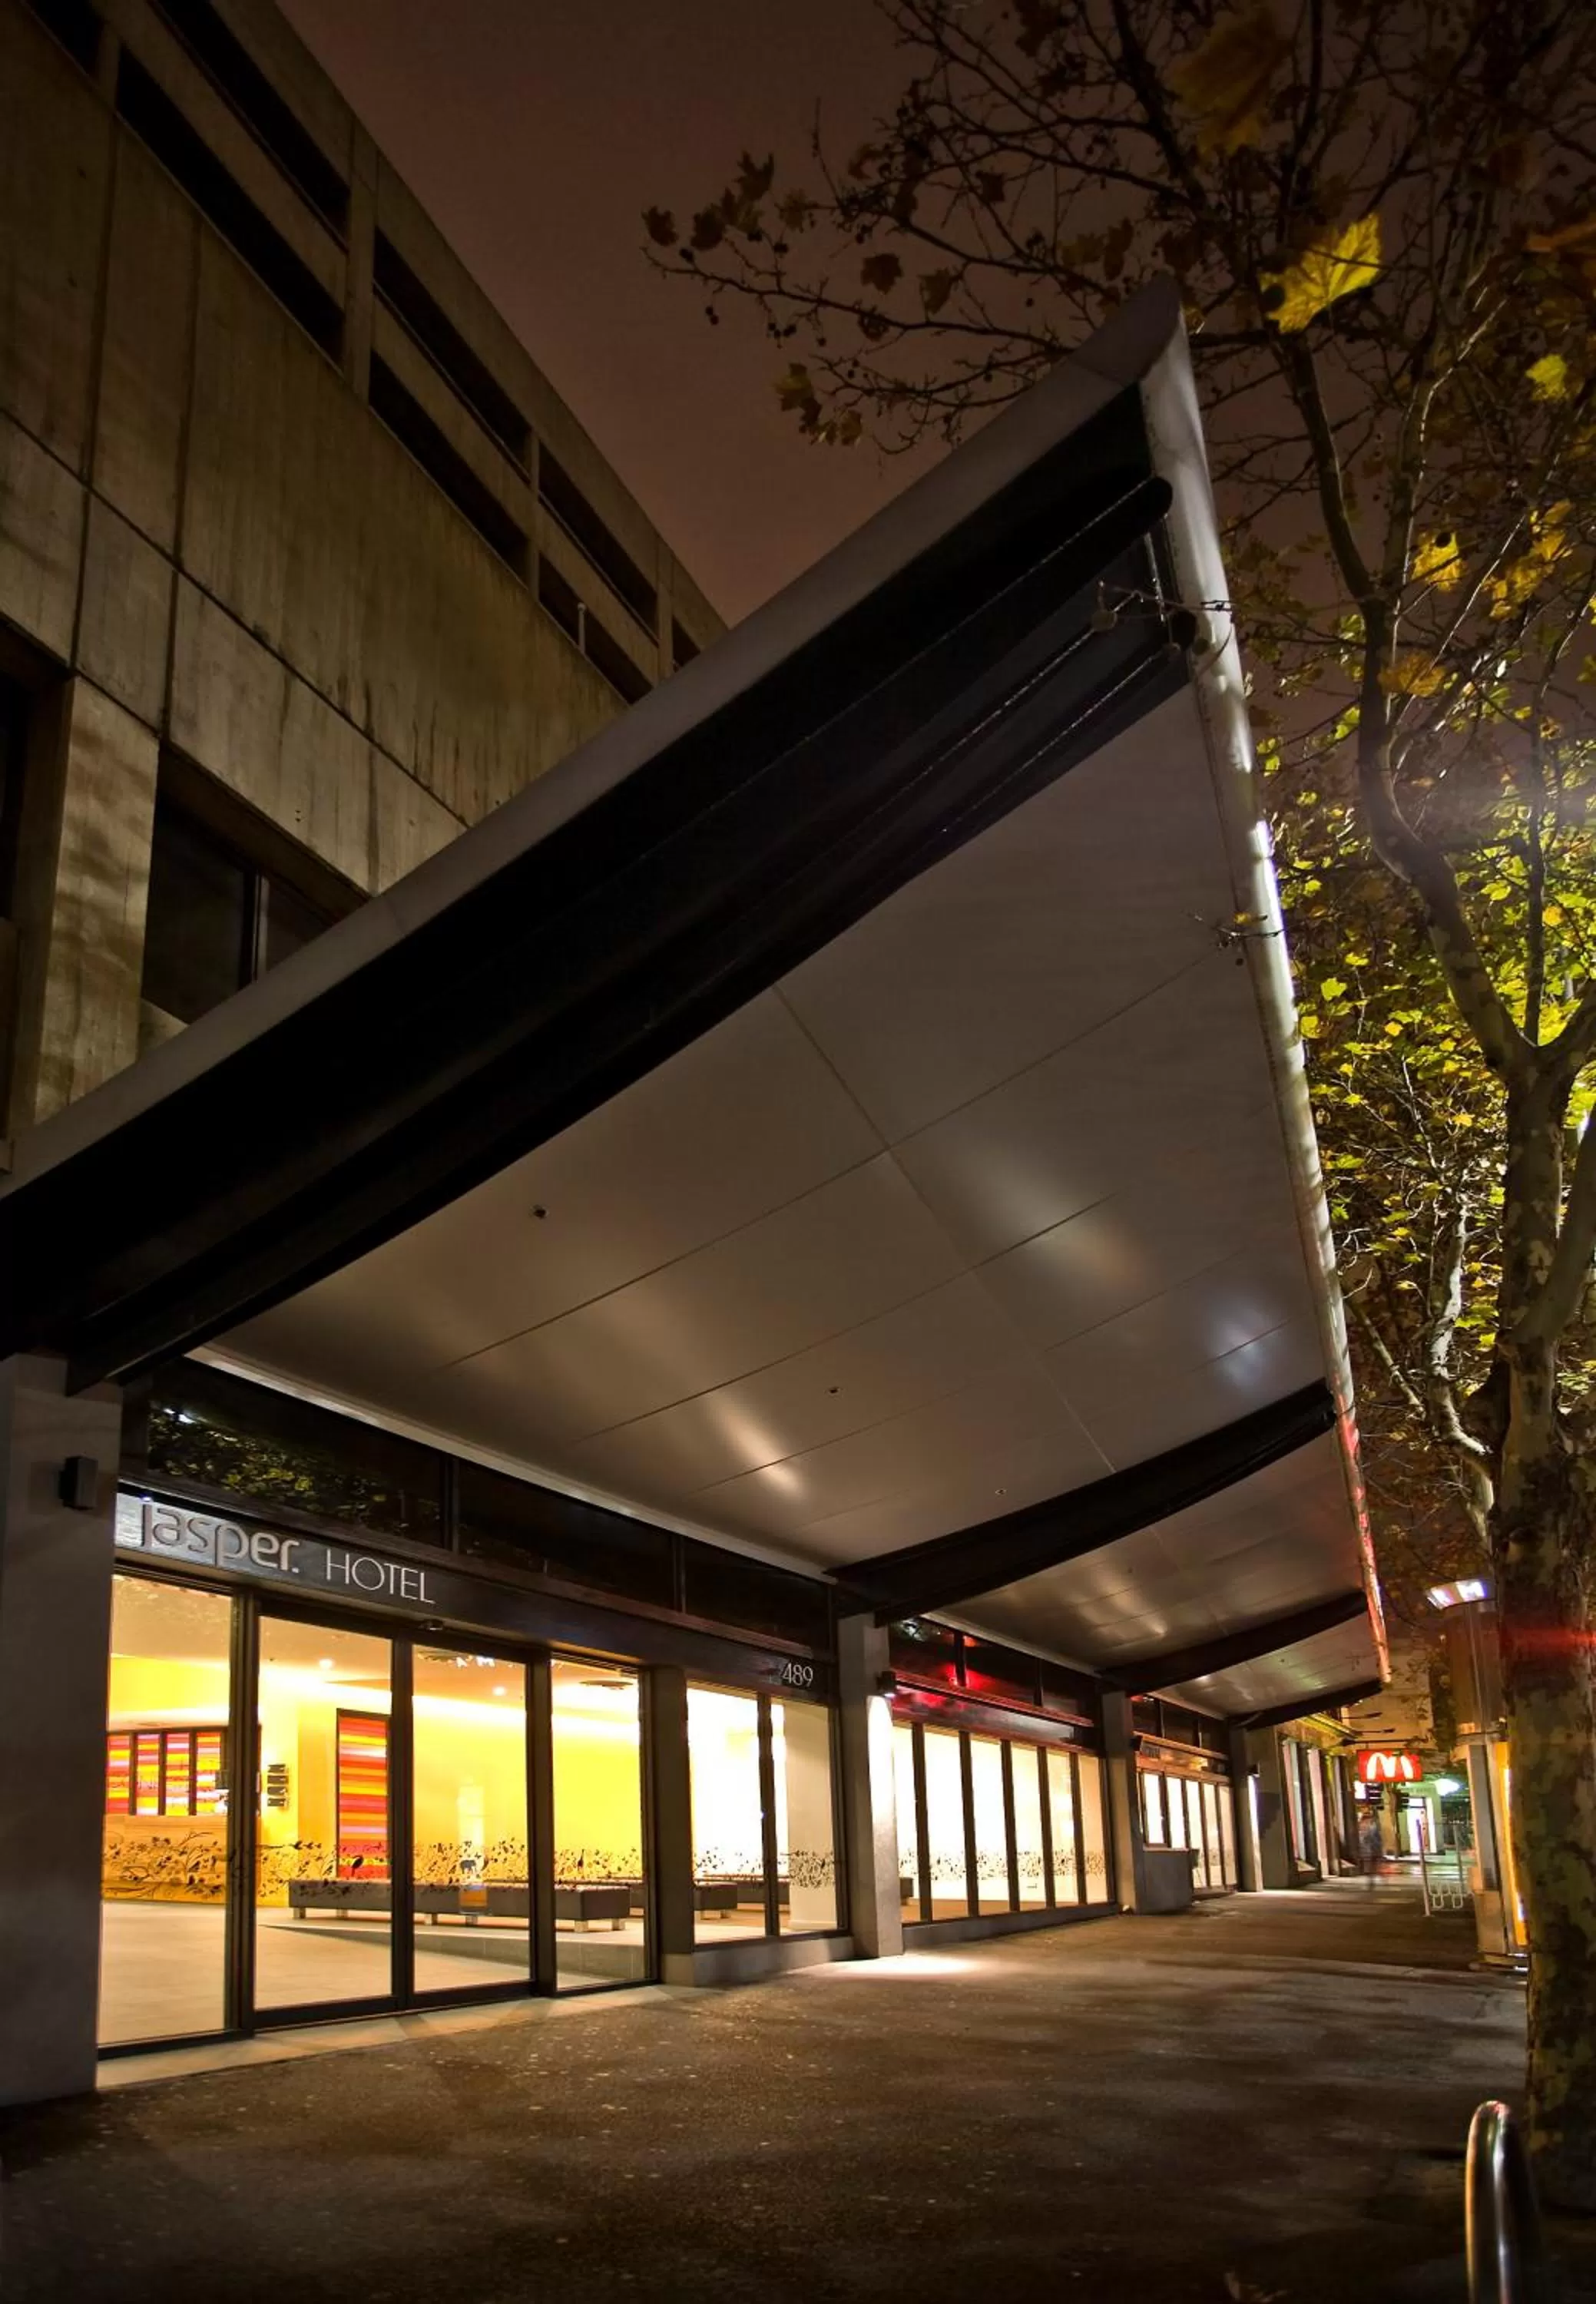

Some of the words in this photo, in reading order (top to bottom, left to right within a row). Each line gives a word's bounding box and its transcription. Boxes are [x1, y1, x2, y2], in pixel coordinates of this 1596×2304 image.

[326, 1548, 435, 1604] HOTEL
[783, 1662, 813, 1687] 489
[1366, 1752, 1414, 1779] M
